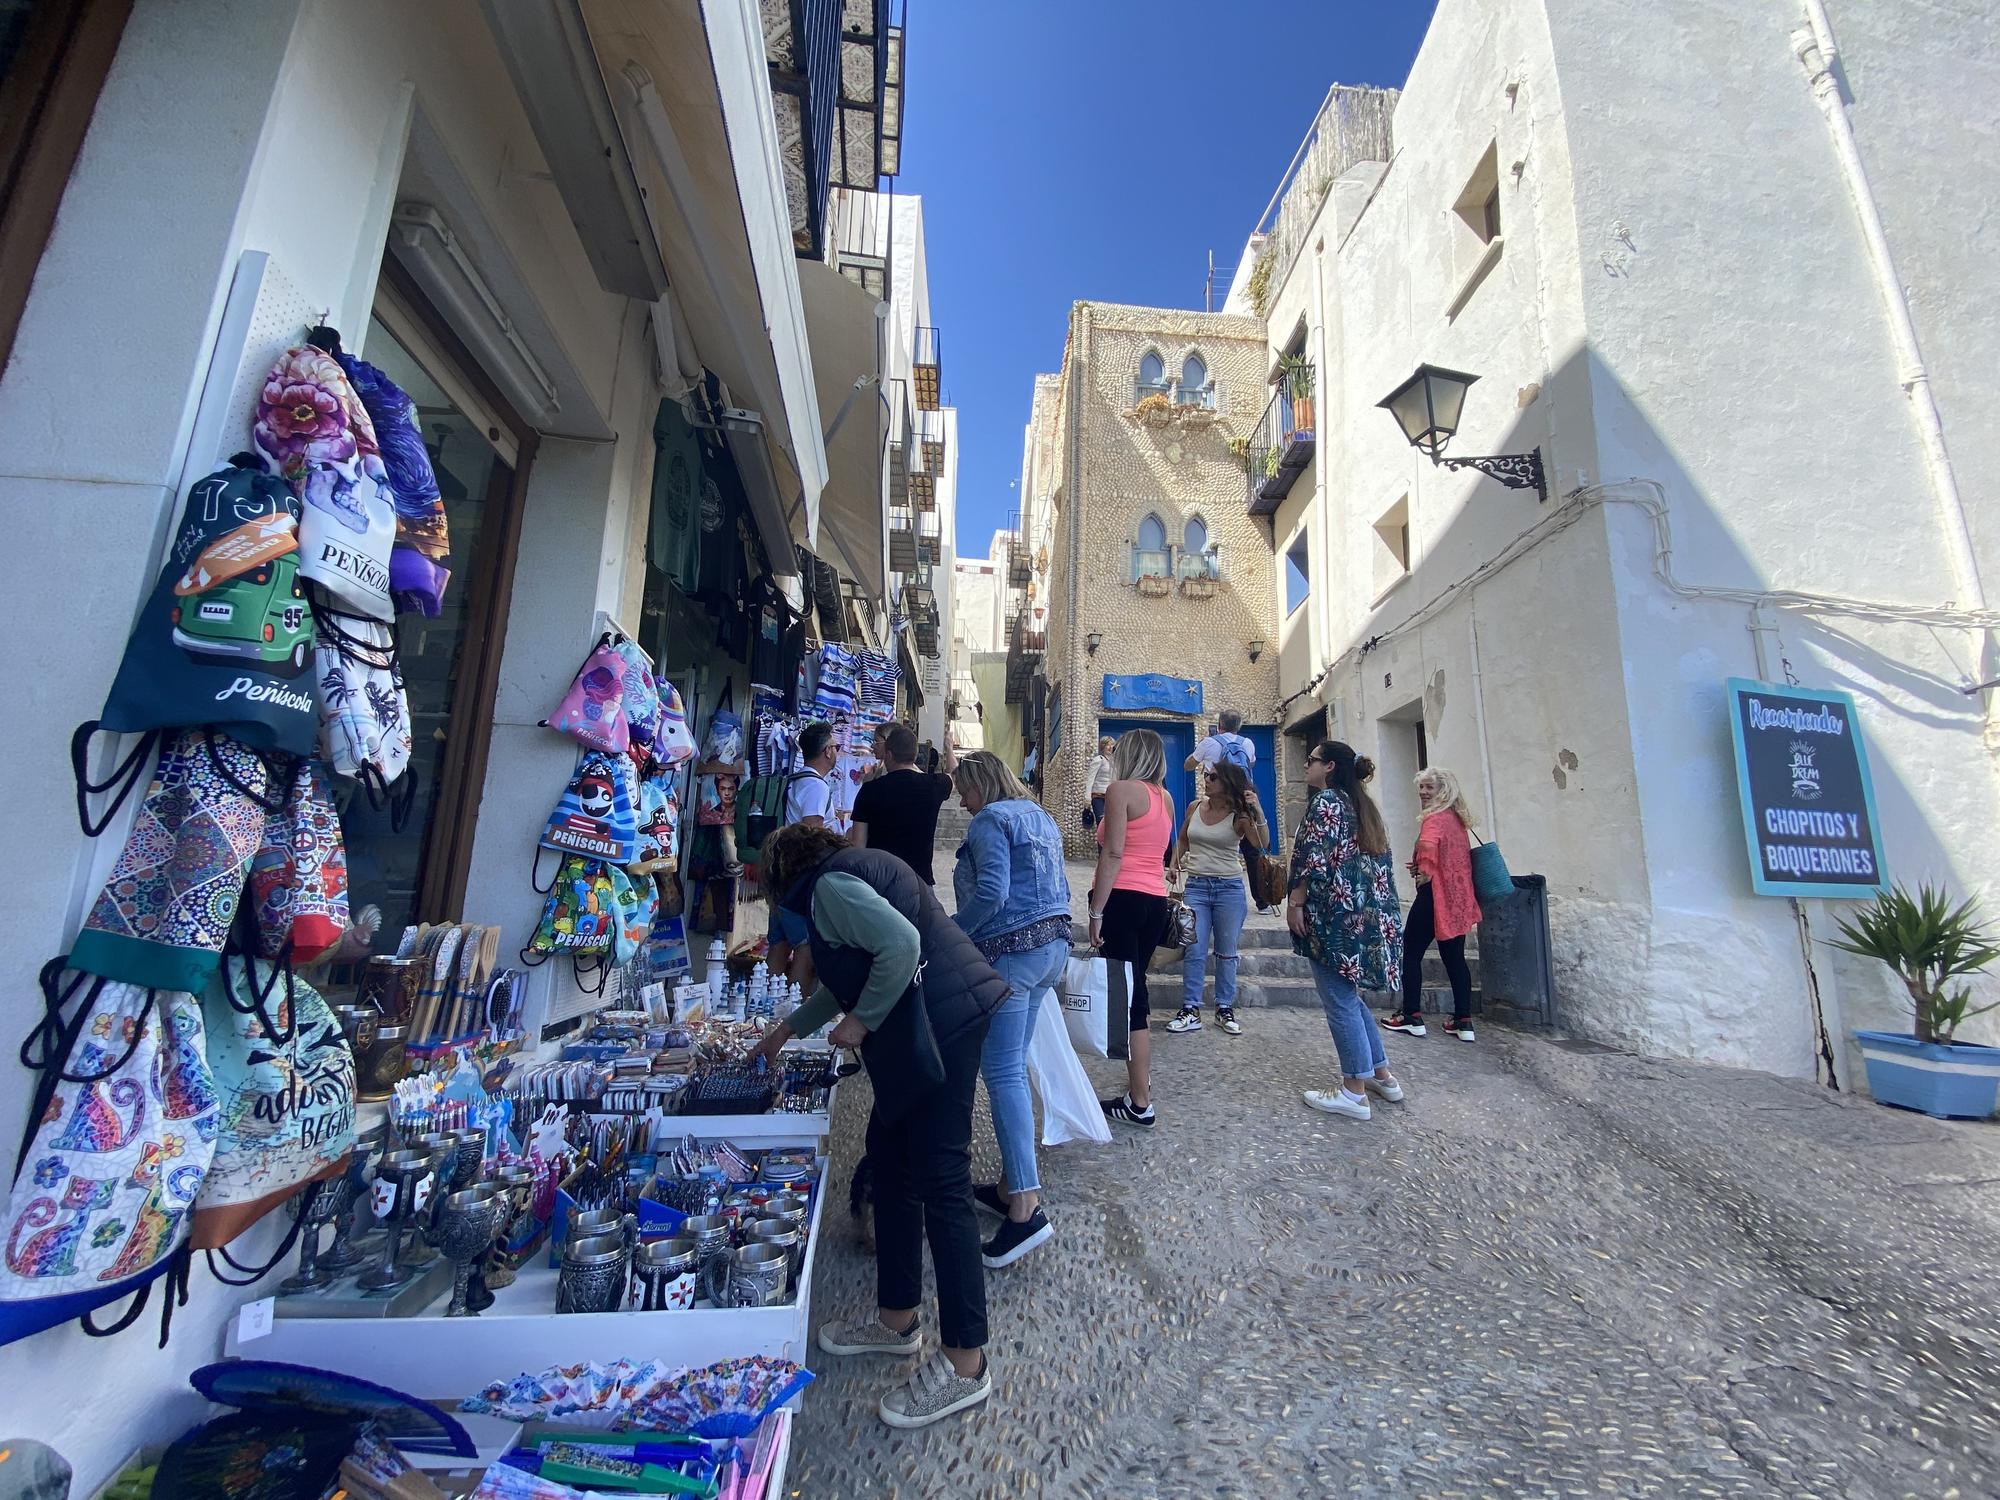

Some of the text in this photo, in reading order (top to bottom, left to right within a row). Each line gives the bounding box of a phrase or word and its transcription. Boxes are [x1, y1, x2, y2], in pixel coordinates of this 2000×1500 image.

[230, 537, 284, 561] FOREVER
[318, 542, 390, 595] PEÑÍSCOL
[284, 608, 303, 628] 95
[215, 677, 313, 713] Peñíscola
[1749, 698, 1844, 735] Recomienda
[1791, 767, 1820, 782] DREAM
[1765, 808, 1860, 839] CHOPITOS Y
[552, 830, 617, 855] PEÑÍSCOLA
[1765, 844, 1873, 876] BOQUERONES
[555, 931, 611, 947] PEÑÍSCOL
[1066, 997, 1088, 1008] LE-HOP
